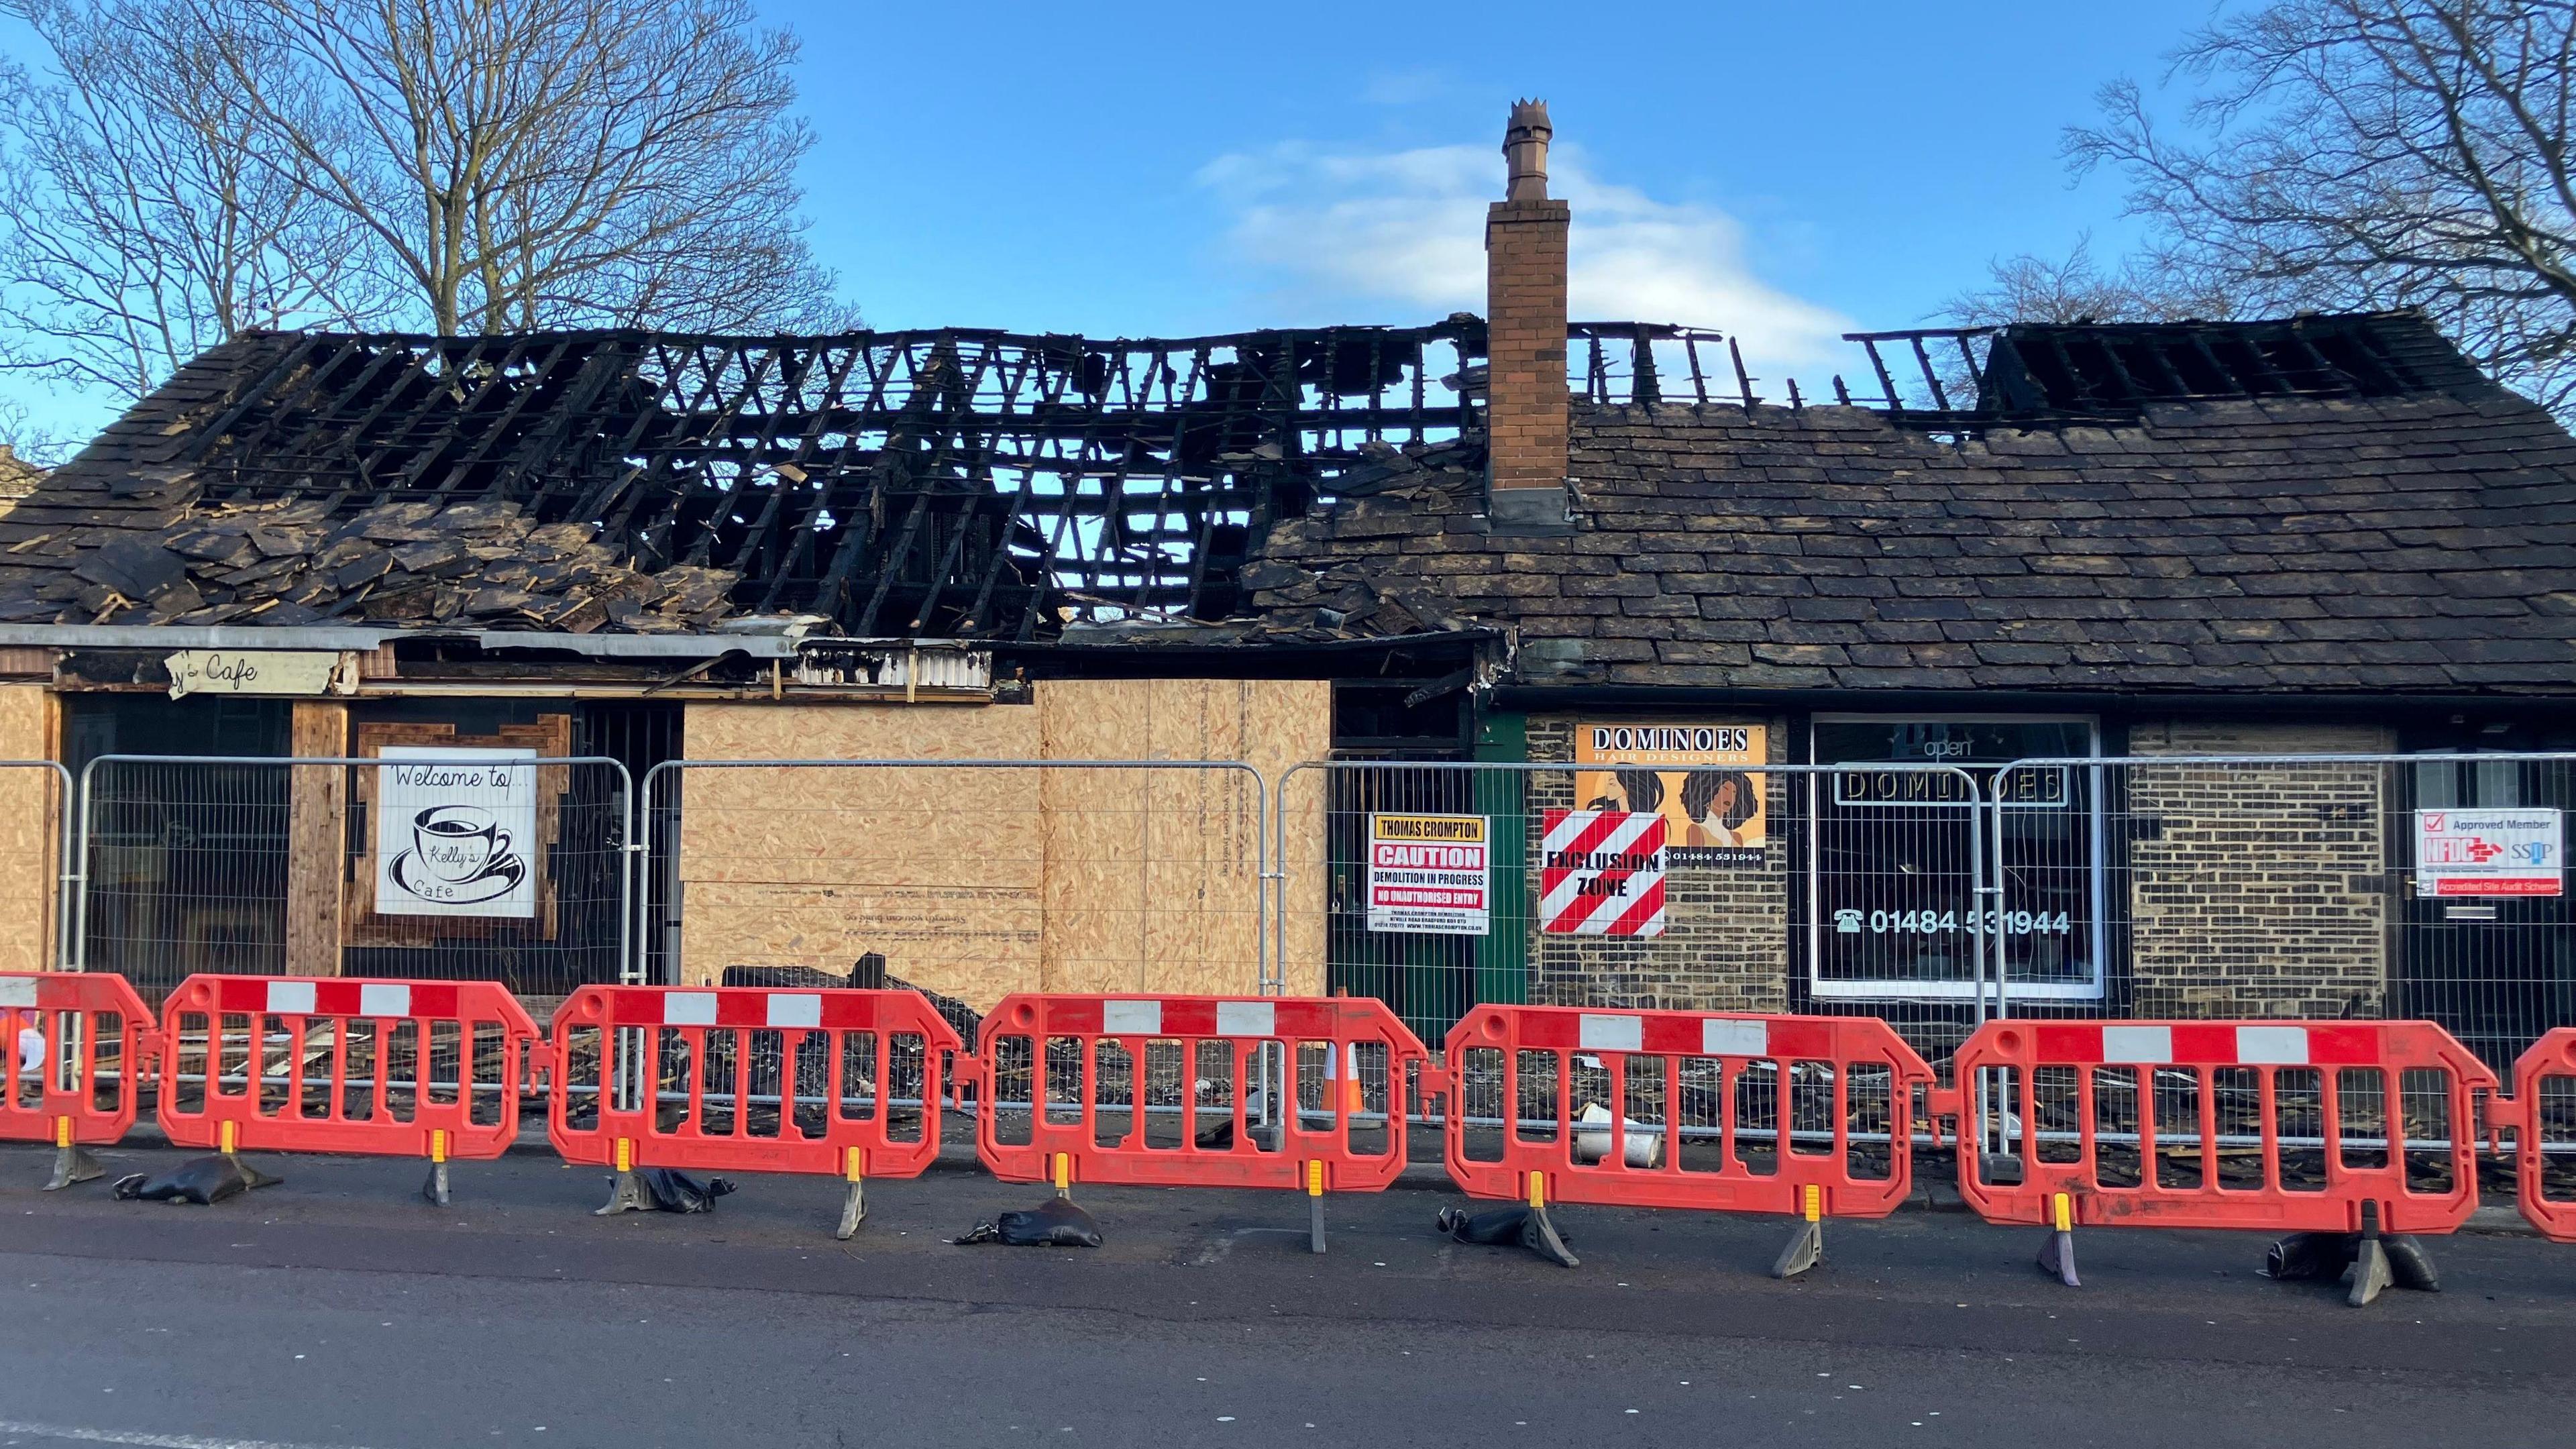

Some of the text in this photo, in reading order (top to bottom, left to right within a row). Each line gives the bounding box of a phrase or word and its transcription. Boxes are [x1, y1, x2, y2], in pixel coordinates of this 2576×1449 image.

[206, 654, 258, 690] Cafe
[1593, 728, 1747, 751] DOMINOES
[1595, 753, 1748, 762] HAIR DESIGNERS
[1925, 741, 1972, 762] open
[390, 765, 483, 786] Welcome
[1381, 820, 1478, 838] THOMAS CROMPTON
[2453, 820, 2551, 831] Approved Member
[429, 845, 480, 868] Kelly's
[1377, 845, 1481, 868] CAUTION
[1672, 853, 1712, 861] 01484
[2424, 838, 2475, 862] NFDC
[1547, 851, 1659, 872] EXCLUSION
[1374, 871, 1483, 885] DEMOLITION IN PROGRESS
[1577, 877, 1627, 896] ZONE
[2439, 881, 2559, 892] Accredited Site Audit Scheme
[414, 880, 454, 898] Cafe
[1378, 890, 1479, 905] NO UNAUTHORISED ENTRY
[1870, 910, 2070, 934] 01484 531944
